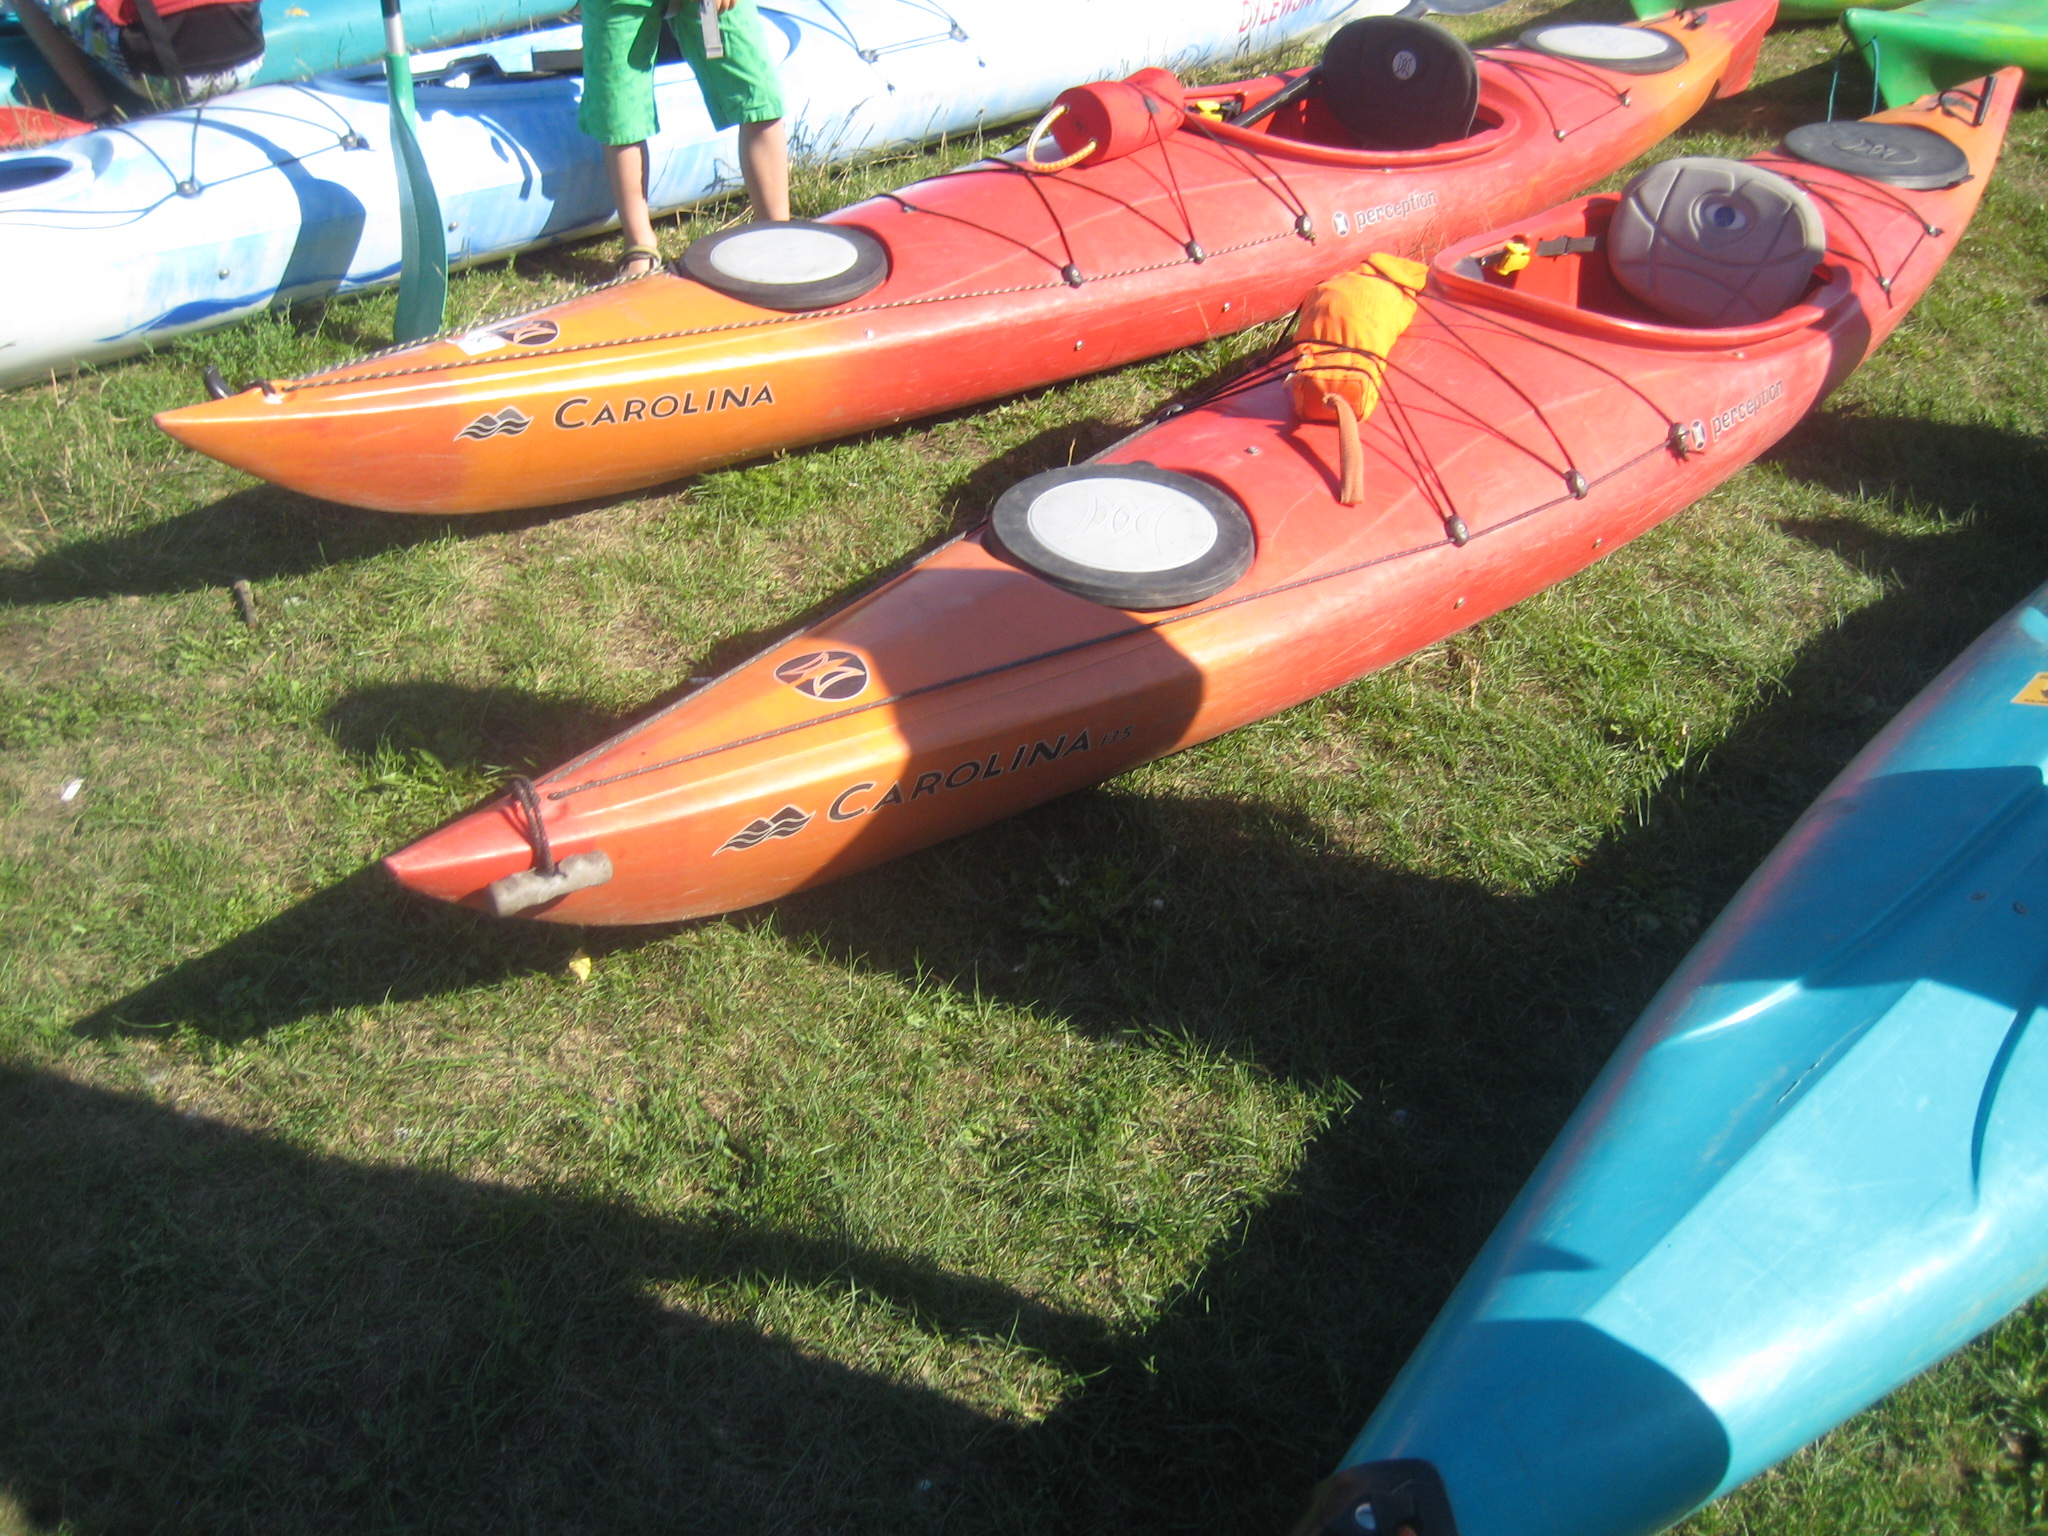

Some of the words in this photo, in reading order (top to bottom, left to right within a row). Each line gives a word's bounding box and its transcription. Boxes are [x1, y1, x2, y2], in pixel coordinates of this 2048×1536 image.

[1354, 190, 1438, 232] perception
[554, 382, 775, 430] CAROLINA
[1711, 381, 1784, 442] perception
[827, 728, 1091, 822] CAROLINA
